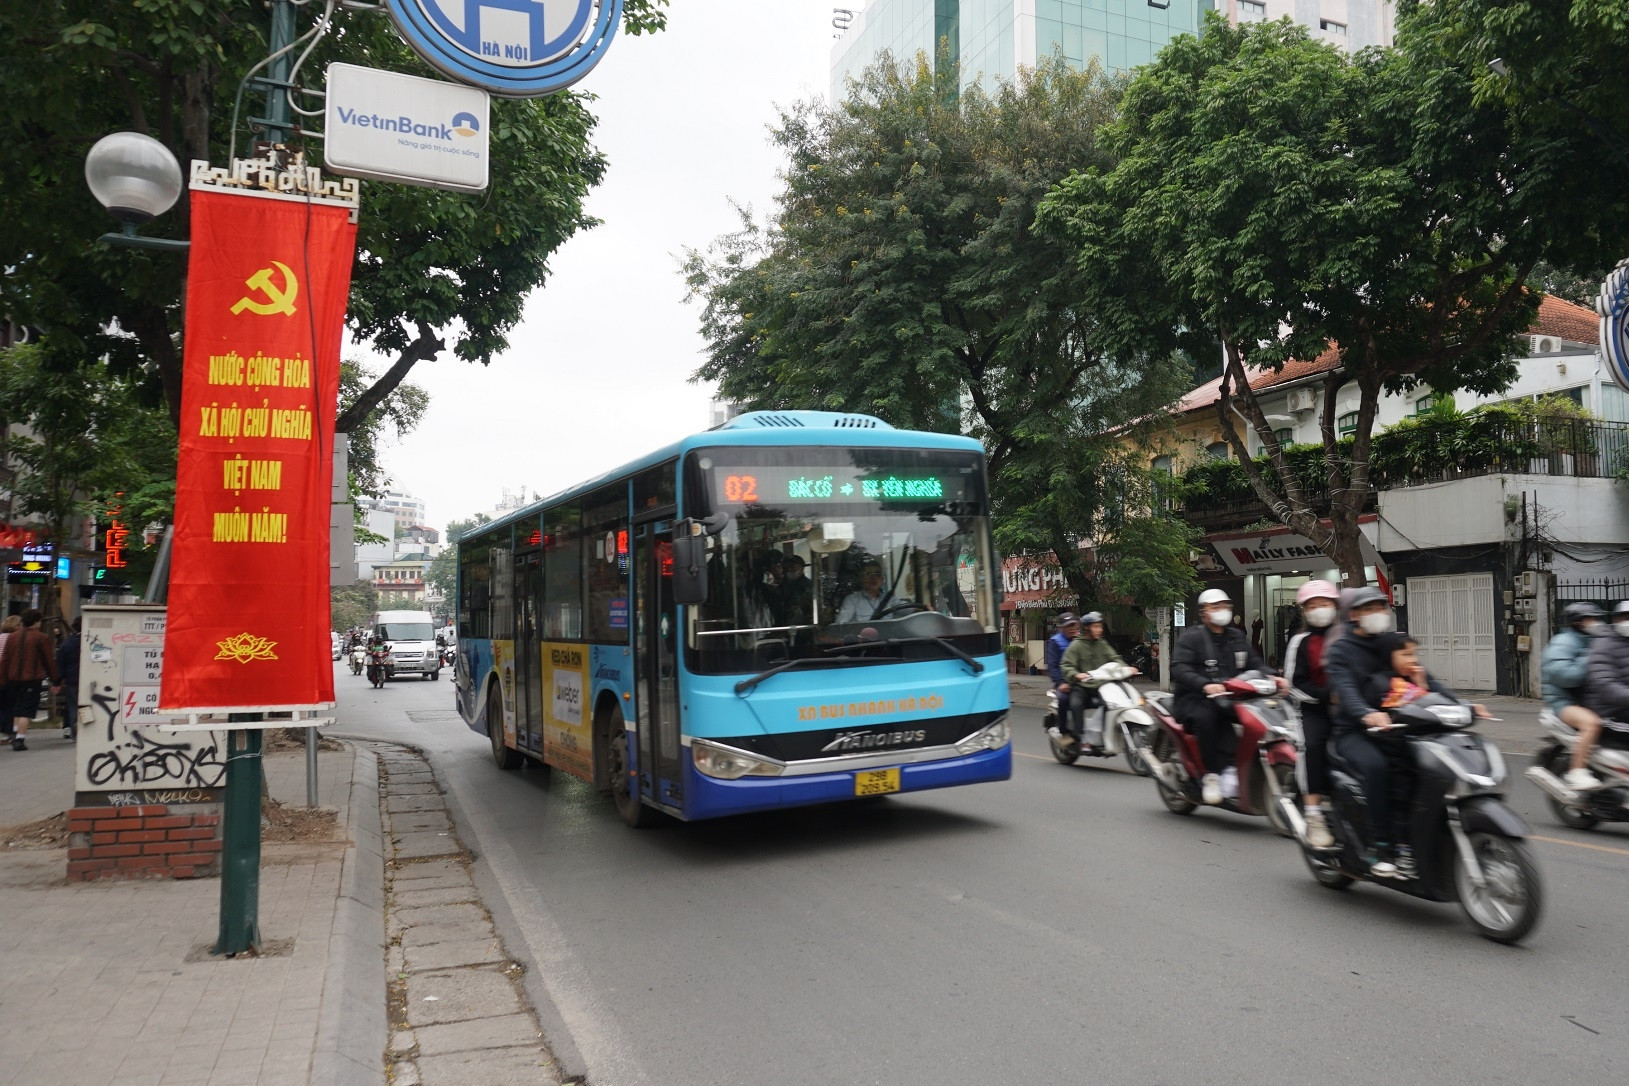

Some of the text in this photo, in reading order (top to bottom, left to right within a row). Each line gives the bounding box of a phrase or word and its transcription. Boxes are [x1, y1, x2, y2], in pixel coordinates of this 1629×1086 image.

[482, 41, 528, 62] HÀ NỘI
[337, 106, 453, 141] VietinBank
[398, 139, 418, 149] Nâng
[208, 351, 310, 392] NƯỚC CỘNG HÒA
[199, 399, 312, 443] XÃ HỘI CHỦ NGHĨA
[224, 453, 282, 496] VIỆT NAM
[724, 475, 758, 502] 02
[213, 506, 288, 543] MUÔN NĂM!
[146, 693, 157, 703] CÓ
[820, 704, 845, 719] BUS
[848, 700, 896, 717] NHANH
[898, 695, 916, 711] HÀ
[919, 693, 944, 713] NỘI
[821, 729, 926, 752] HANOIBUS
